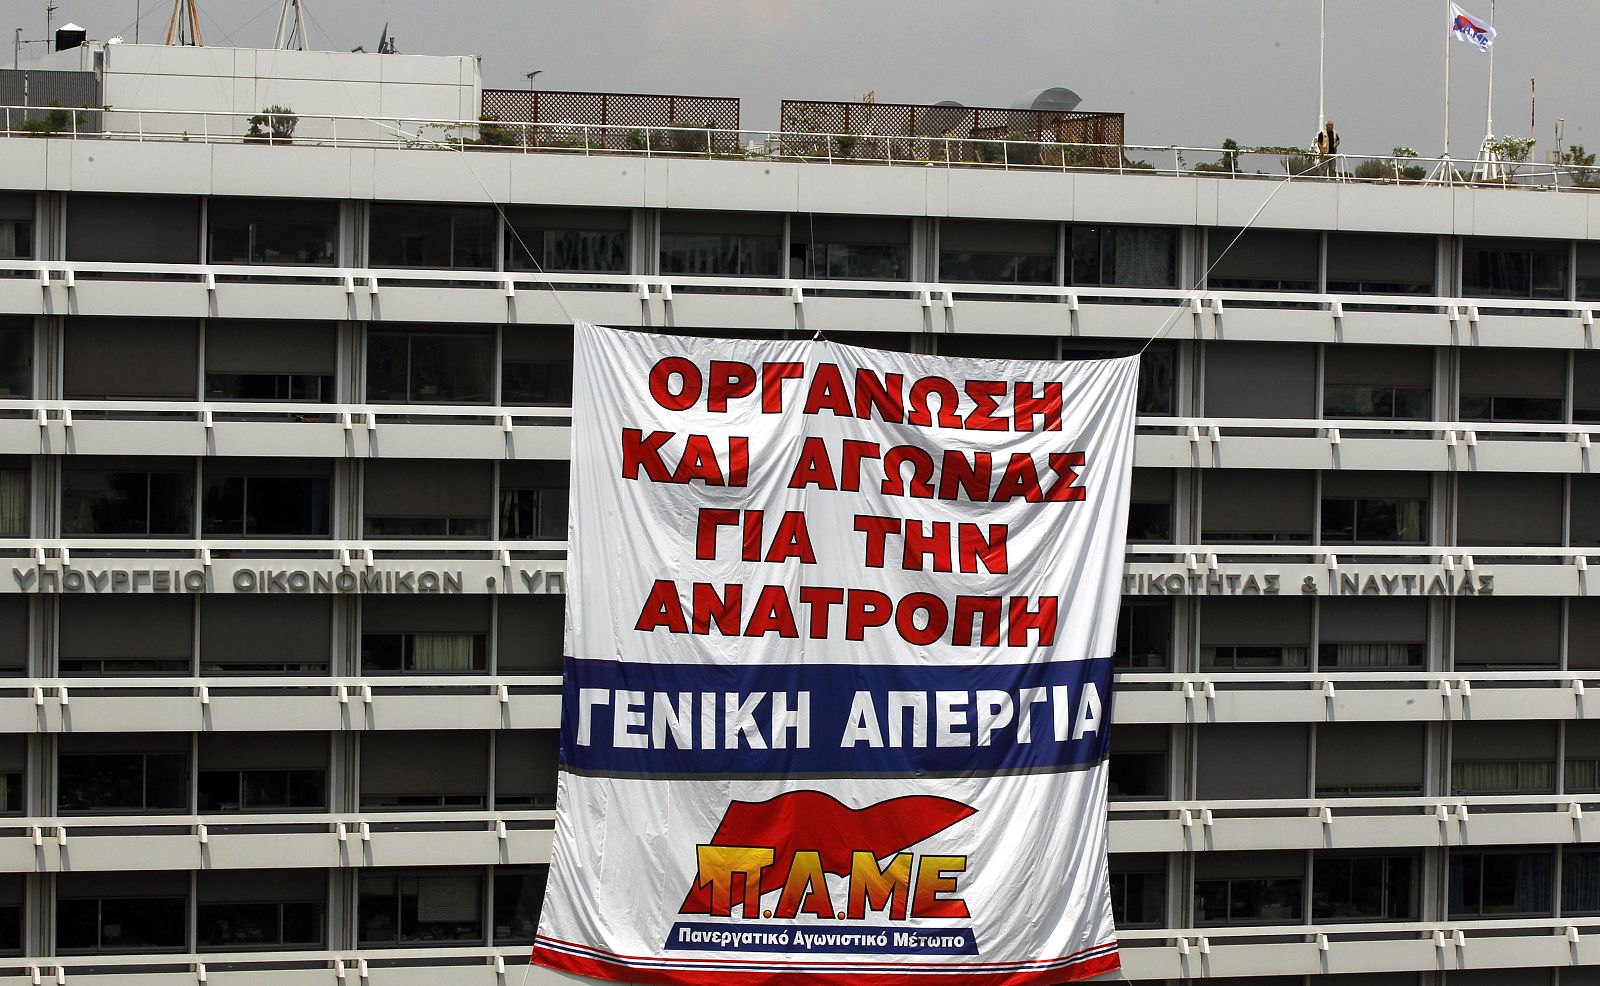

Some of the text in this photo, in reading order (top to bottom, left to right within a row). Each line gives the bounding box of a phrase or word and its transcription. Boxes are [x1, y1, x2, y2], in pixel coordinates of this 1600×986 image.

[648, 356, 1063, 432] ΟΡΓΑΝΩΣΗ
[621, 428, 1086, 503] ΚΑΙ ΑΓΩΝΑΣ
[696, 507, 1008, 575] ΓΙΑ ΤΗΝ
[12, 568, 206, 592] ΥΠΟΥΡΓΕΙΟ
[233, 569, 463, 593] ΟΙΚΟΝΟΜΙΚΩΝ
[634, 579, 1059, 648] ΑΝΑΤΡΟΠΗ
[1302, 575, 1318, 593] &
[1341, 573, 1494, 594] ΝΑΥΤΙΛΙΑΣ
[577, 682, 1102, 751] ΓΕΝΙΚΗ ΑΠΕΡΓΙΑ
[678, 927, 965, 949] Πανεργατικό Αγωνιστικό Μέτωπο
